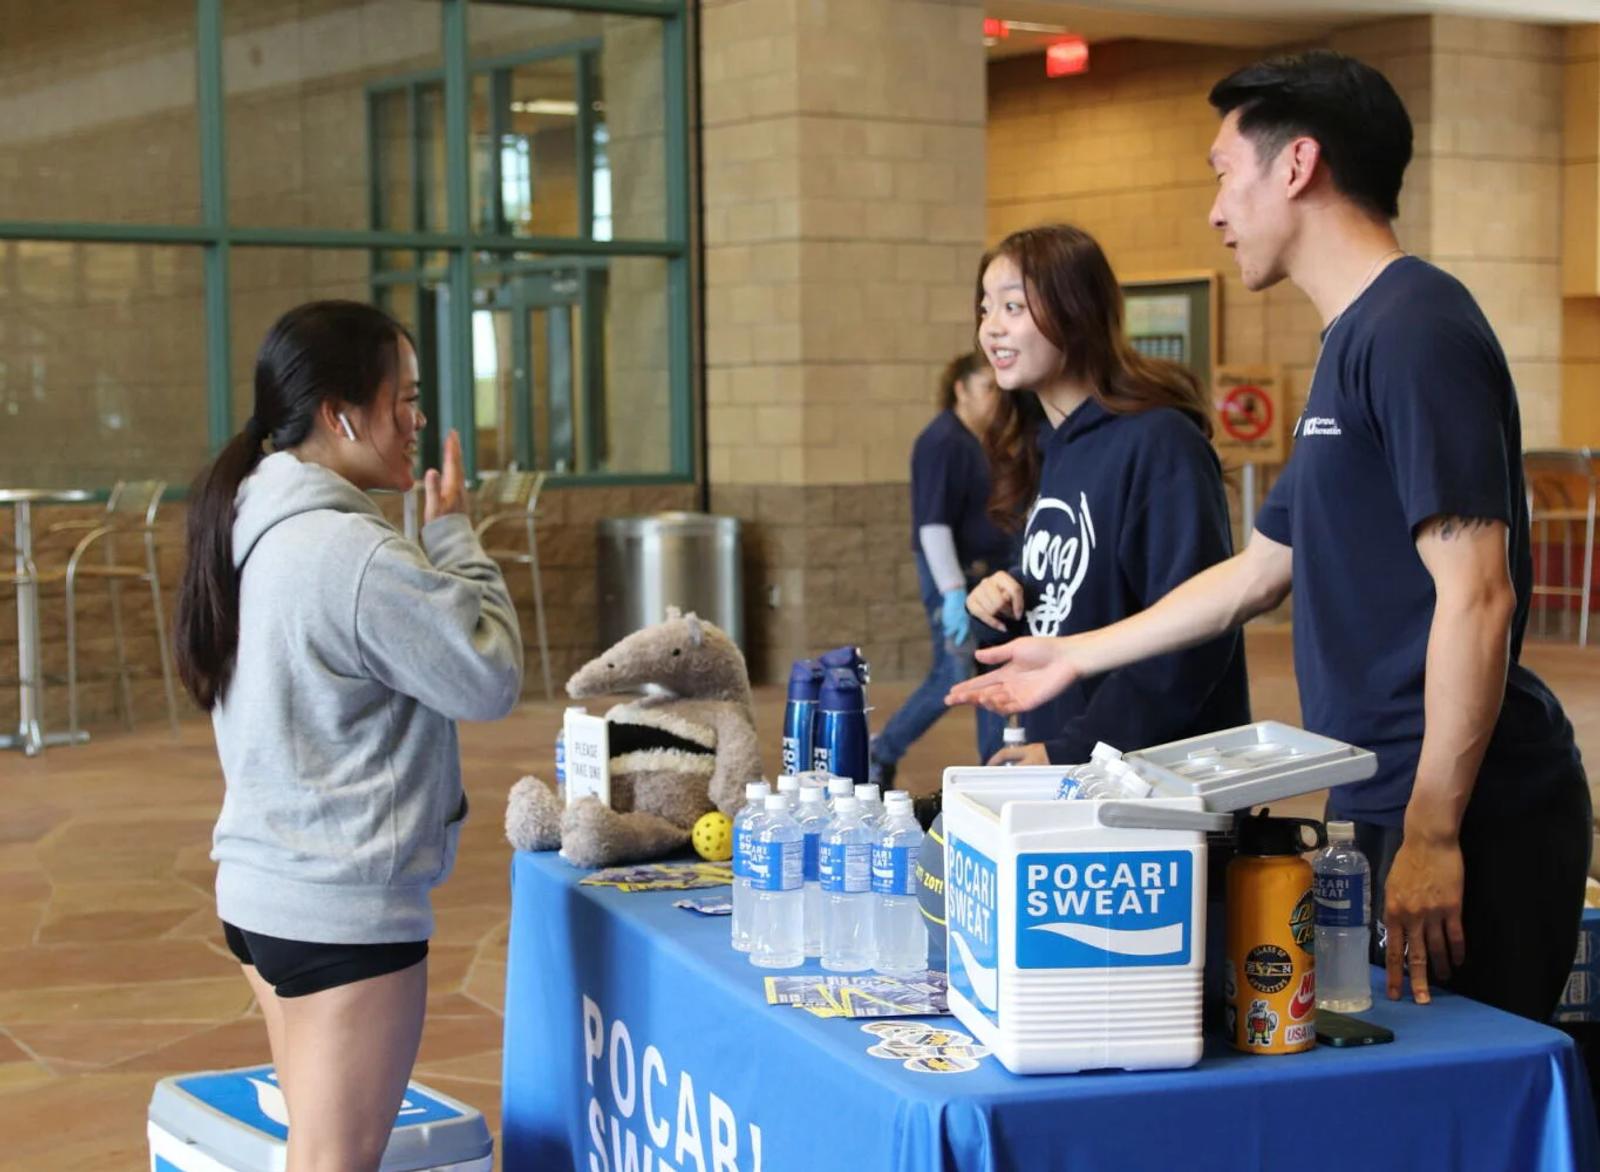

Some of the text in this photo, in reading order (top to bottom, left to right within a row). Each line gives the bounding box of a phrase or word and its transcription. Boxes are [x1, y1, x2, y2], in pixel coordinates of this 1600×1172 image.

[574, 741, 598, 759] PLEASE
[949, 844, 995, 911] POCARI
[1027, 861, 1178, 890] POCARI
[949, 882, 991, 945] SWEAT
[1026, 888, 1165, 917] SWEAT
